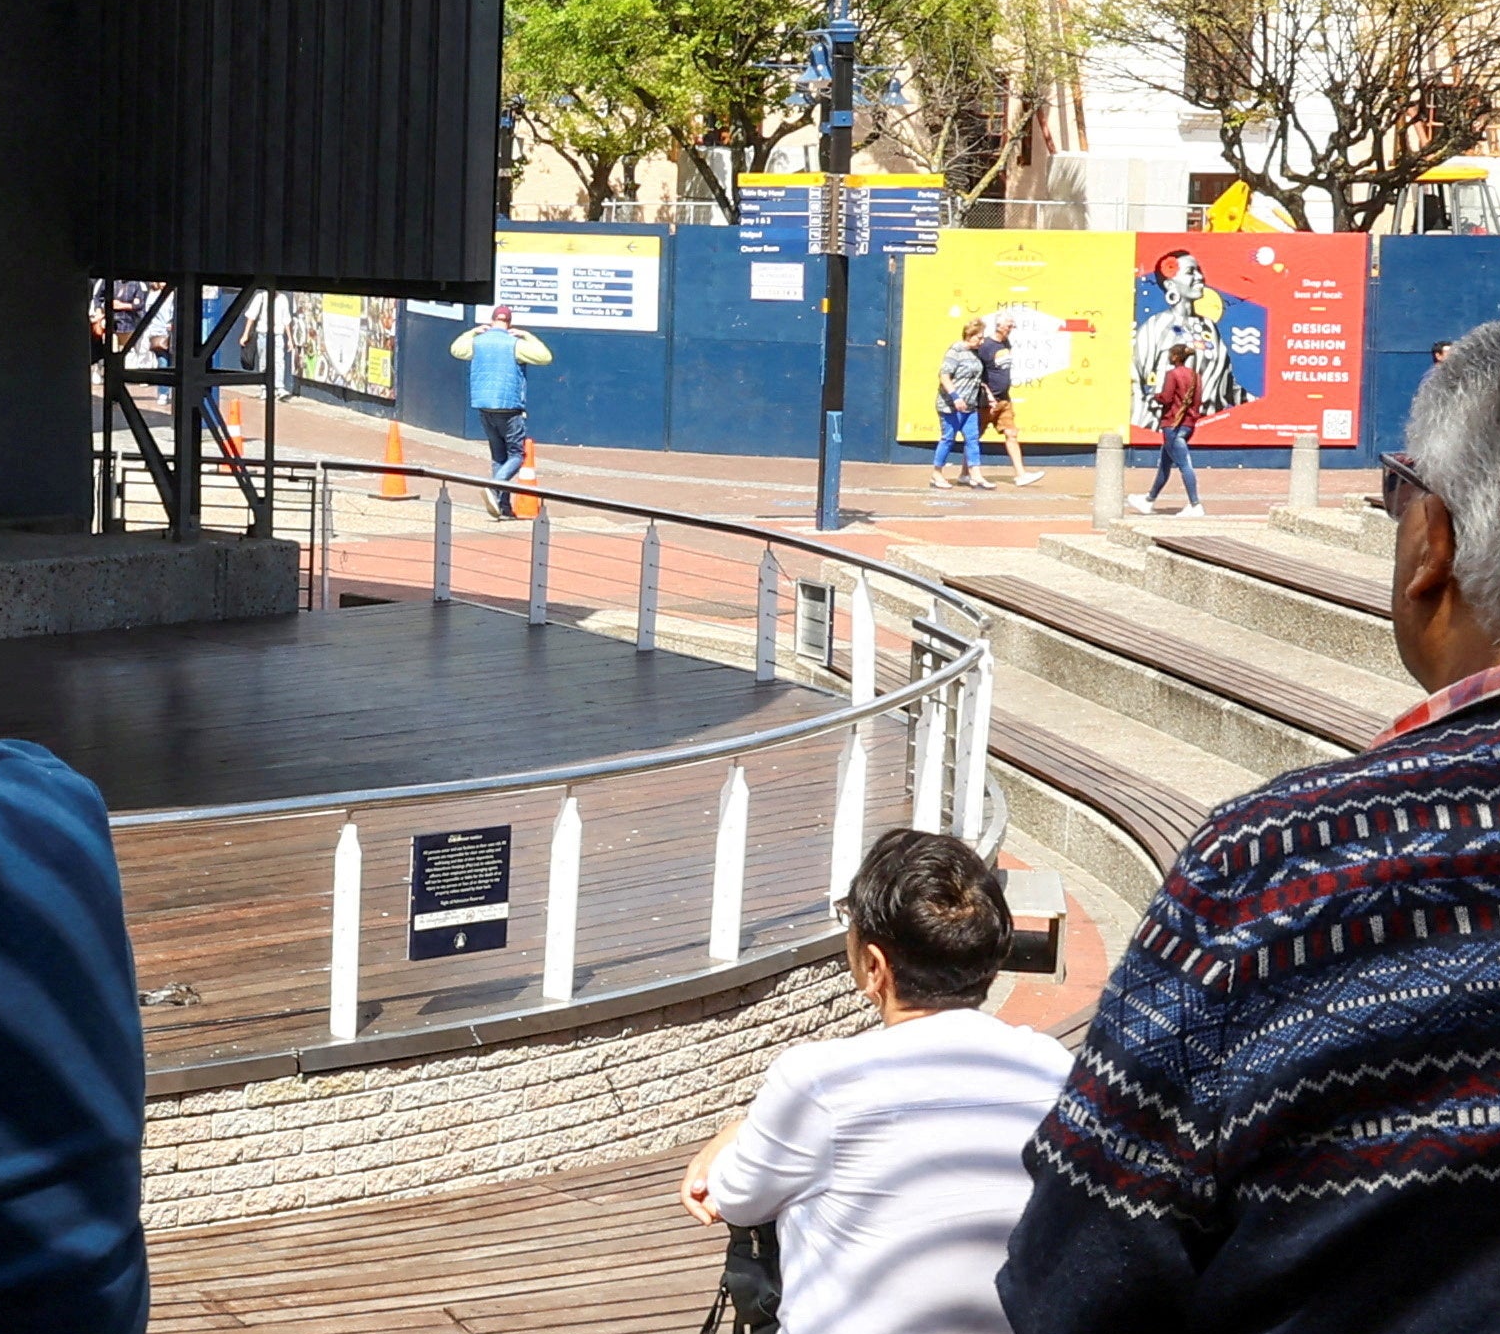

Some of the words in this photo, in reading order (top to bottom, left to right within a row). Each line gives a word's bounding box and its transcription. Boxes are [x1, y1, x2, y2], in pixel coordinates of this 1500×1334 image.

[1302, 279, 1322, 287] Shop
[1322, 279, 1336, 287] the
[1294, 291, 1311, 299] best
[1312, 291, 1322, 299] of
[997, 301, 1040, 311] MEET
[1292, 323, 1342, 334] DESIGN
[1287, 339, 1346, 350] FASHION
[1290, 355, 1329, 366] FOOD
[1332, 356, 1342, 366] &
[1282, 371, 1349, 383] WELLNESS
